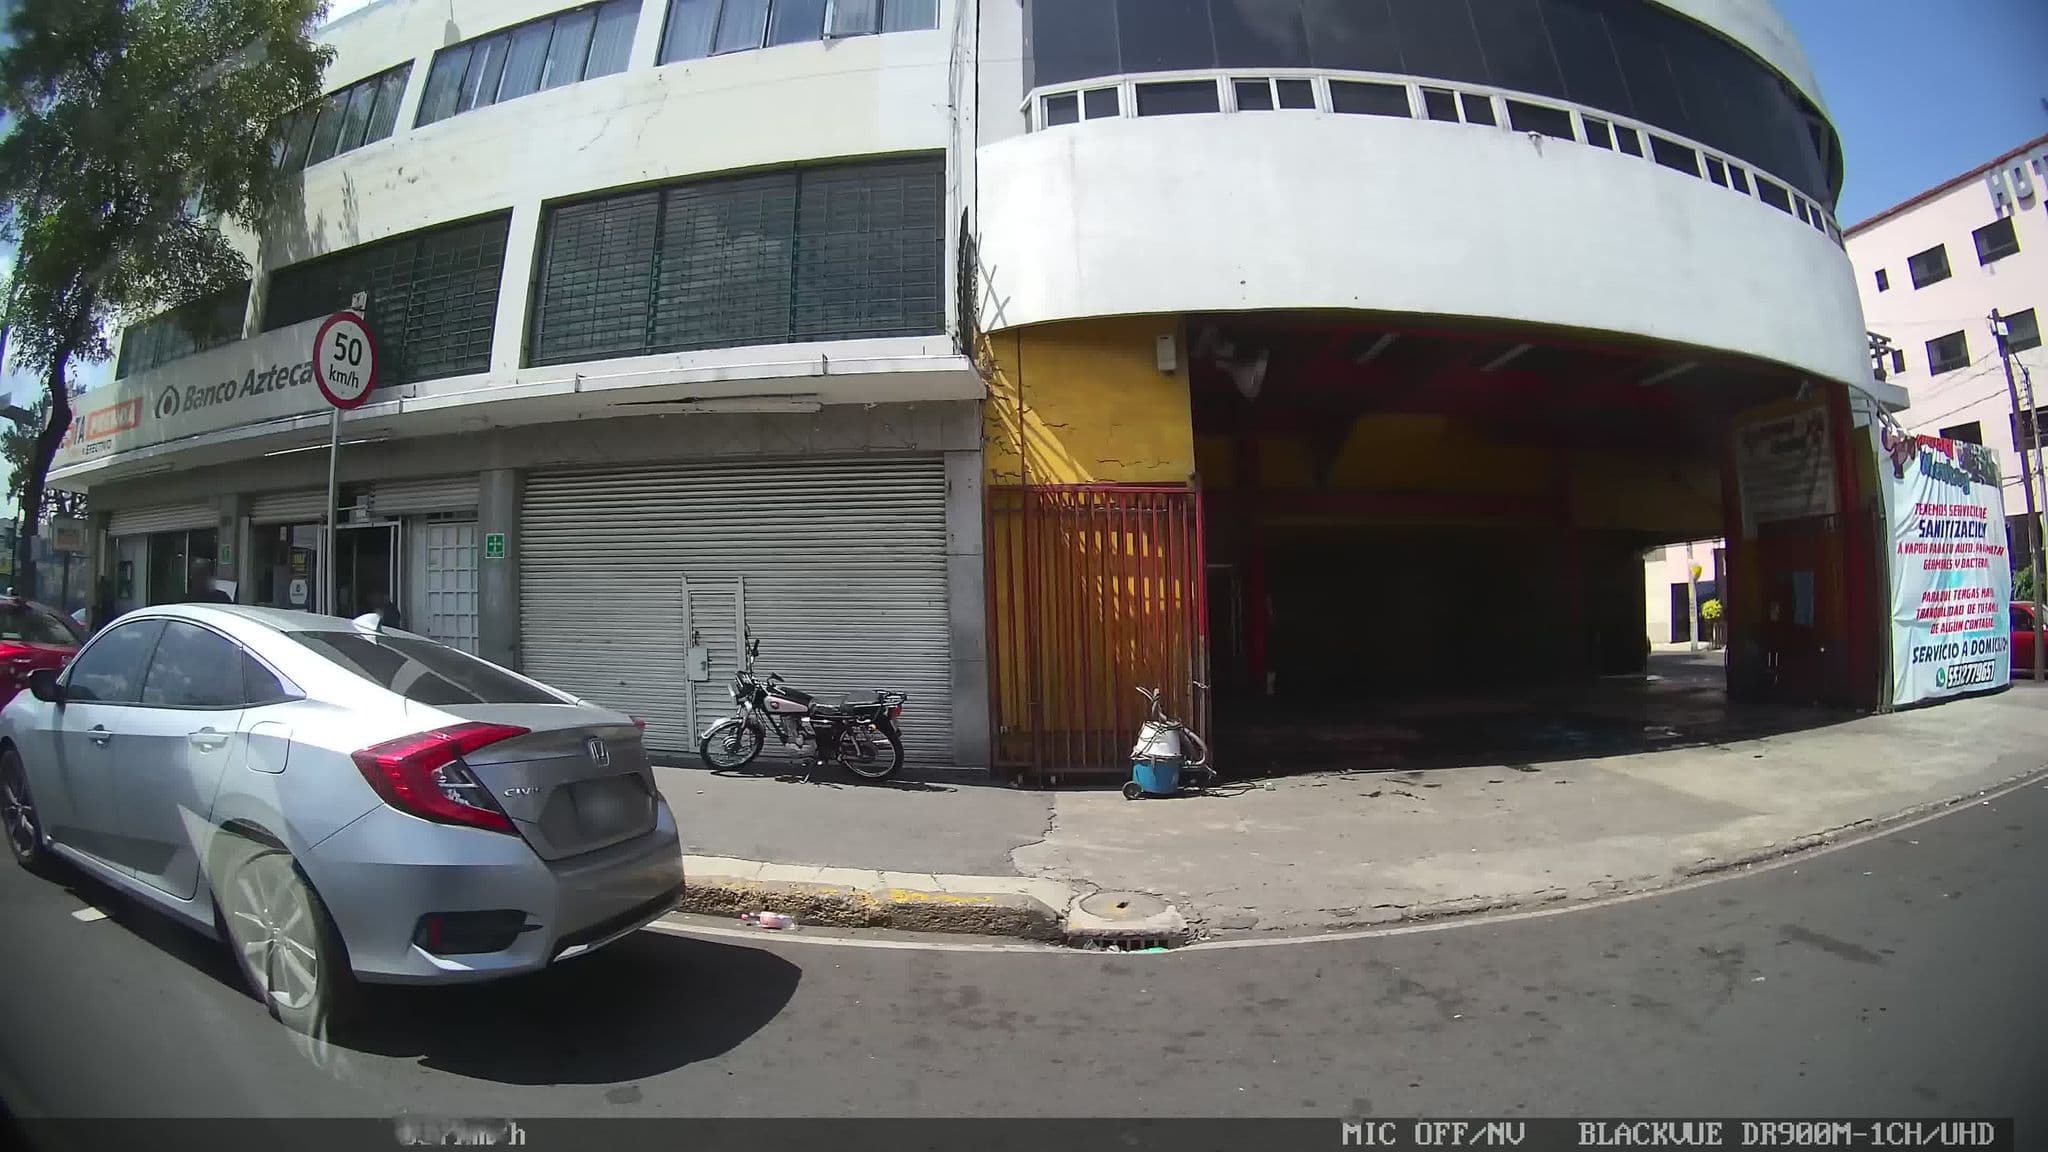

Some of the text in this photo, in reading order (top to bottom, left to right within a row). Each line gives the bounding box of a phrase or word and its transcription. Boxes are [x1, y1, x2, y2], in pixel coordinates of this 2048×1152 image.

[333, 332, 362, 366] 50
[329, 363, 359, 388] km/h
[183, 361, 313, 412] Banco Azteca
[1897, 542, 1903, 555] A
[1953, 587, 1979, 601] TENGAS
[1967, 603, 1976, 615] DE
[1930, 623, 1939, 635] DE
[1940, 620, 1964, 634] ALGUN
[1912, 642, 1960, 664] SERVICIO
[1961, 640, 1968, 657] A
